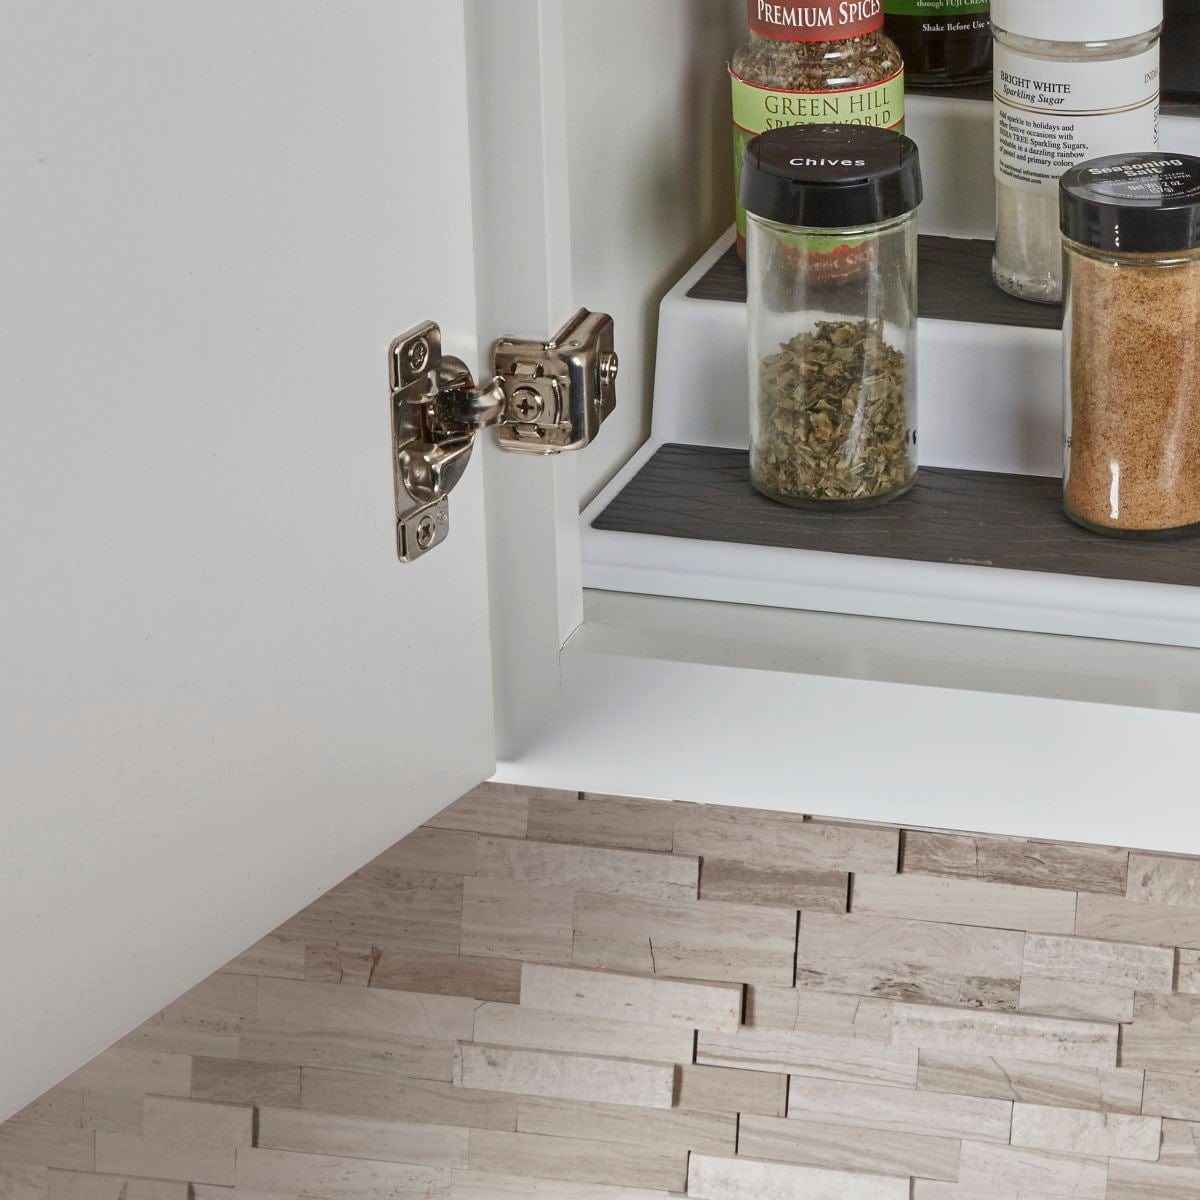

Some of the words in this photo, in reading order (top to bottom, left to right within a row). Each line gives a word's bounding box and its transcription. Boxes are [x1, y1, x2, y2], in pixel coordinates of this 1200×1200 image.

[923, 23, 944, 31] Shake
[948, 22, 970, 30] Before
[1001, 71, 1031, 88] BRIGHT
[1033, 81, 1071, 94] WHITE
[764, 95, 839, 117] GREEN
[850, 87, 890, 113] HILL
[1003, 85, 1035, 103] Sparkling
[1038, 93, 1065, 105] Sugar
[1033, 120, 1060, 132] holidays
[1026, 130, 1057, 139] occasions
[1013, 134, 1028, 142] TREE
[1030, 139, 1061, 150] Sparkling
[1063, 142, 1088, 150] Sugars,
[790, 157, 865, 166] Chives
[1088, 159, 1183, 175] Seasoning
[1124, 167, 1163, 176] Salt
